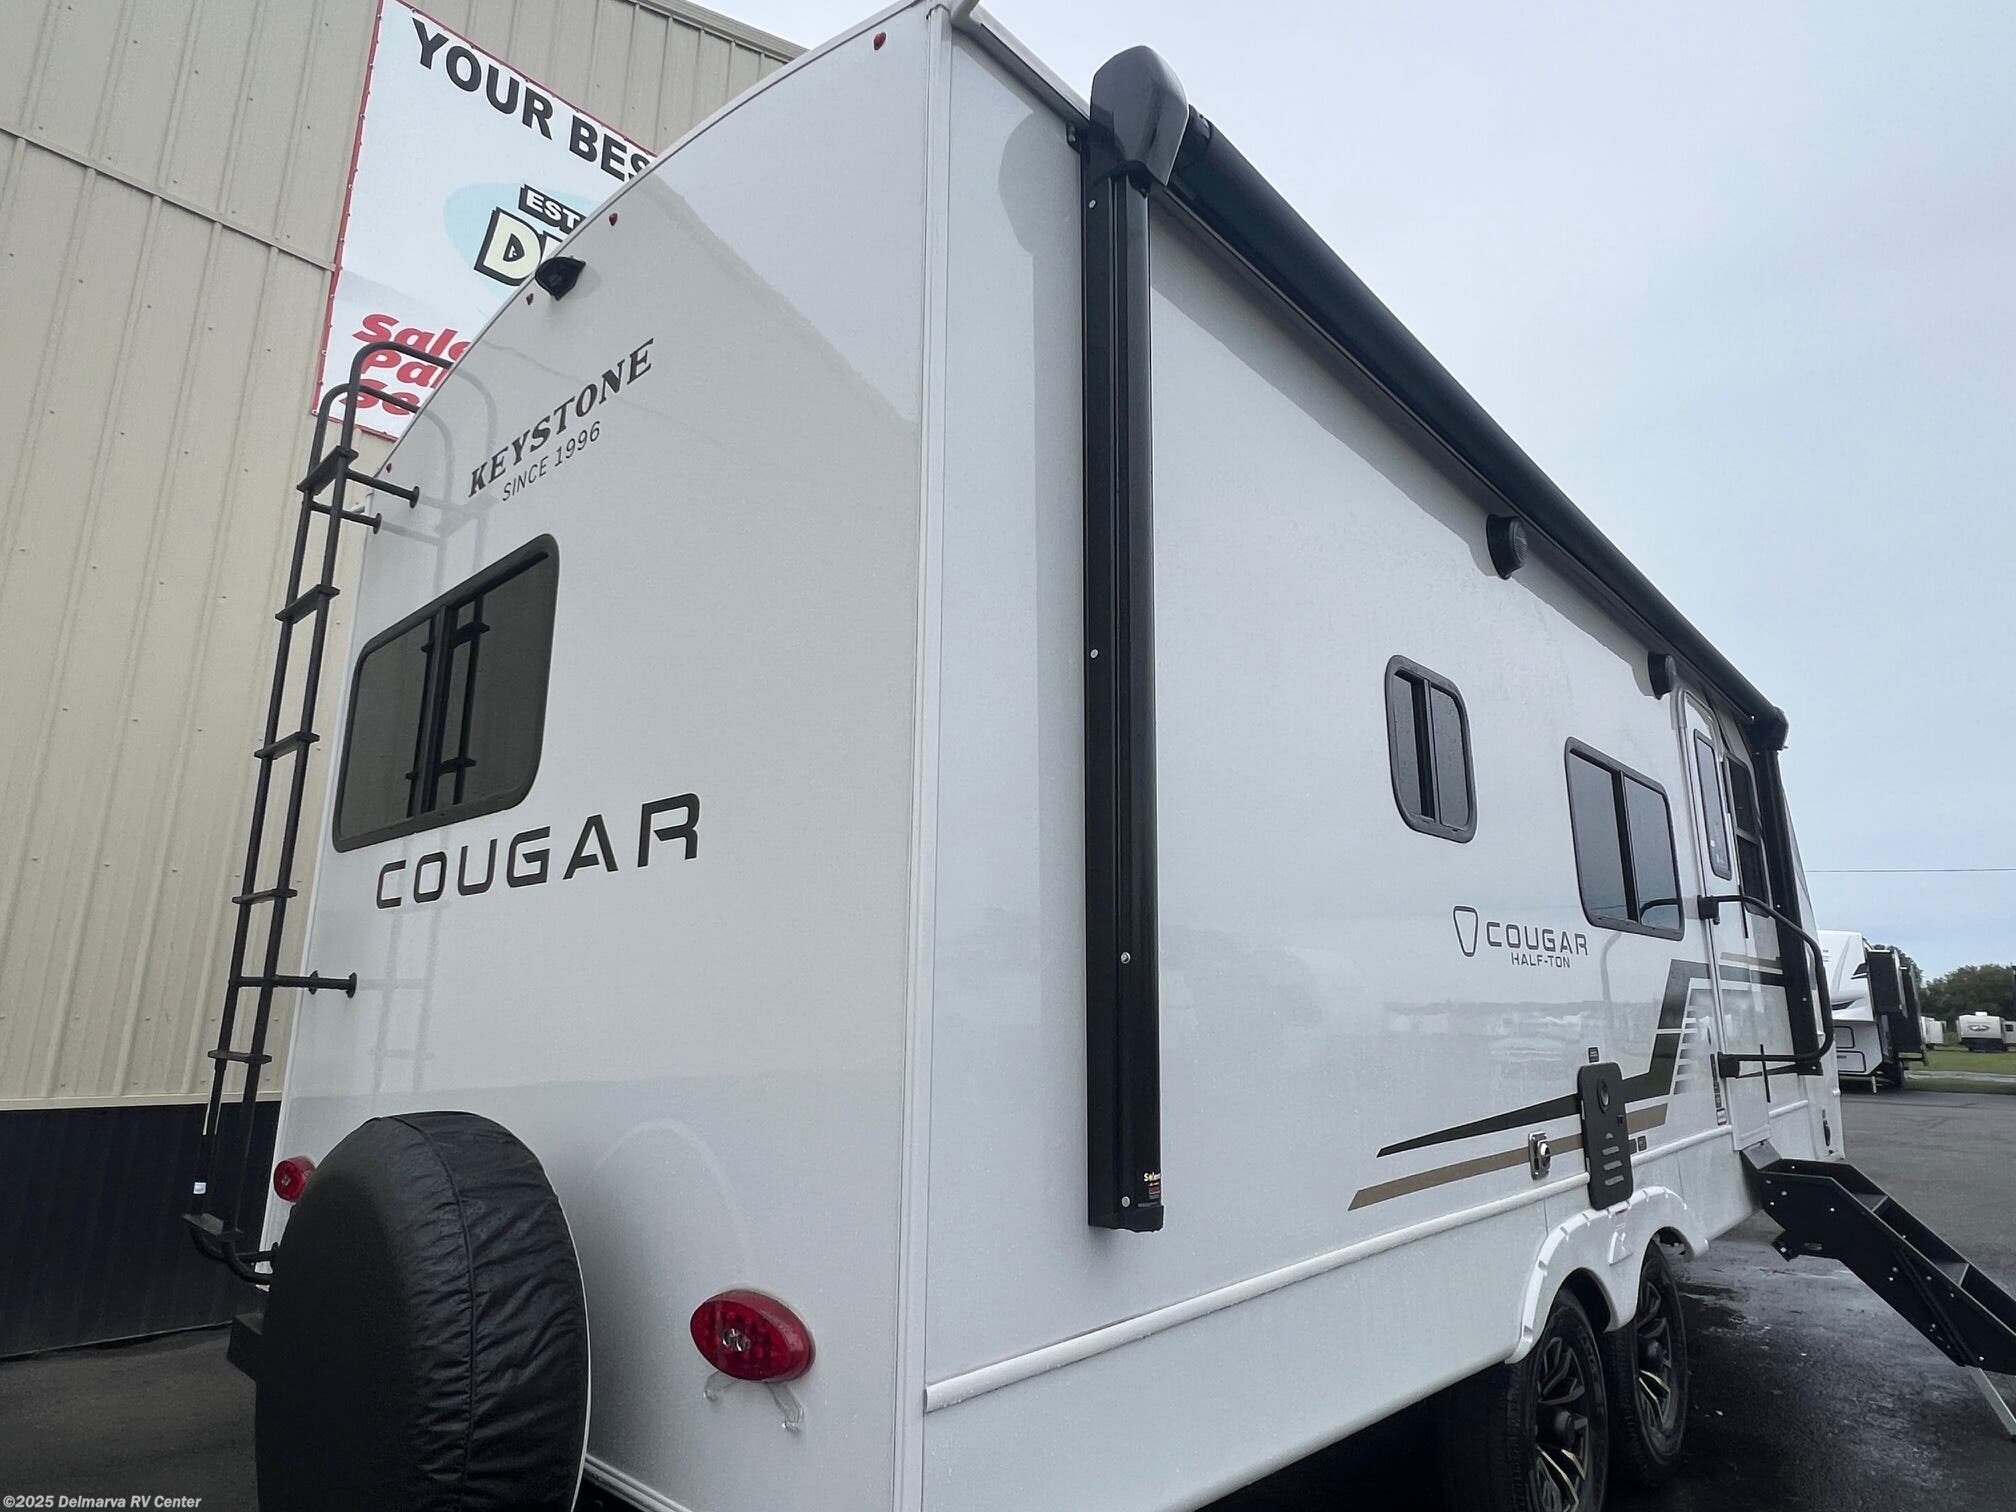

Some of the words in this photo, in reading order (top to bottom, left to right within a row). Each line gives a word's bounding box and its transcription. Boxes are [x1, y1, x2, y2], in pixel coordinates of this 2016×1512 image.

[412, 17, 553, 140] YOUR
[468, 337, 654, 498] KEYSTONE
[502, 455, 549, 502] SINCE
[554, 420, 601, 467] 1996
[376, 792, 701, 910] COUGAR
[1486, 921, 1588, 956] COUGAR
[1511, 952, 1571, 968] HALF-TON
